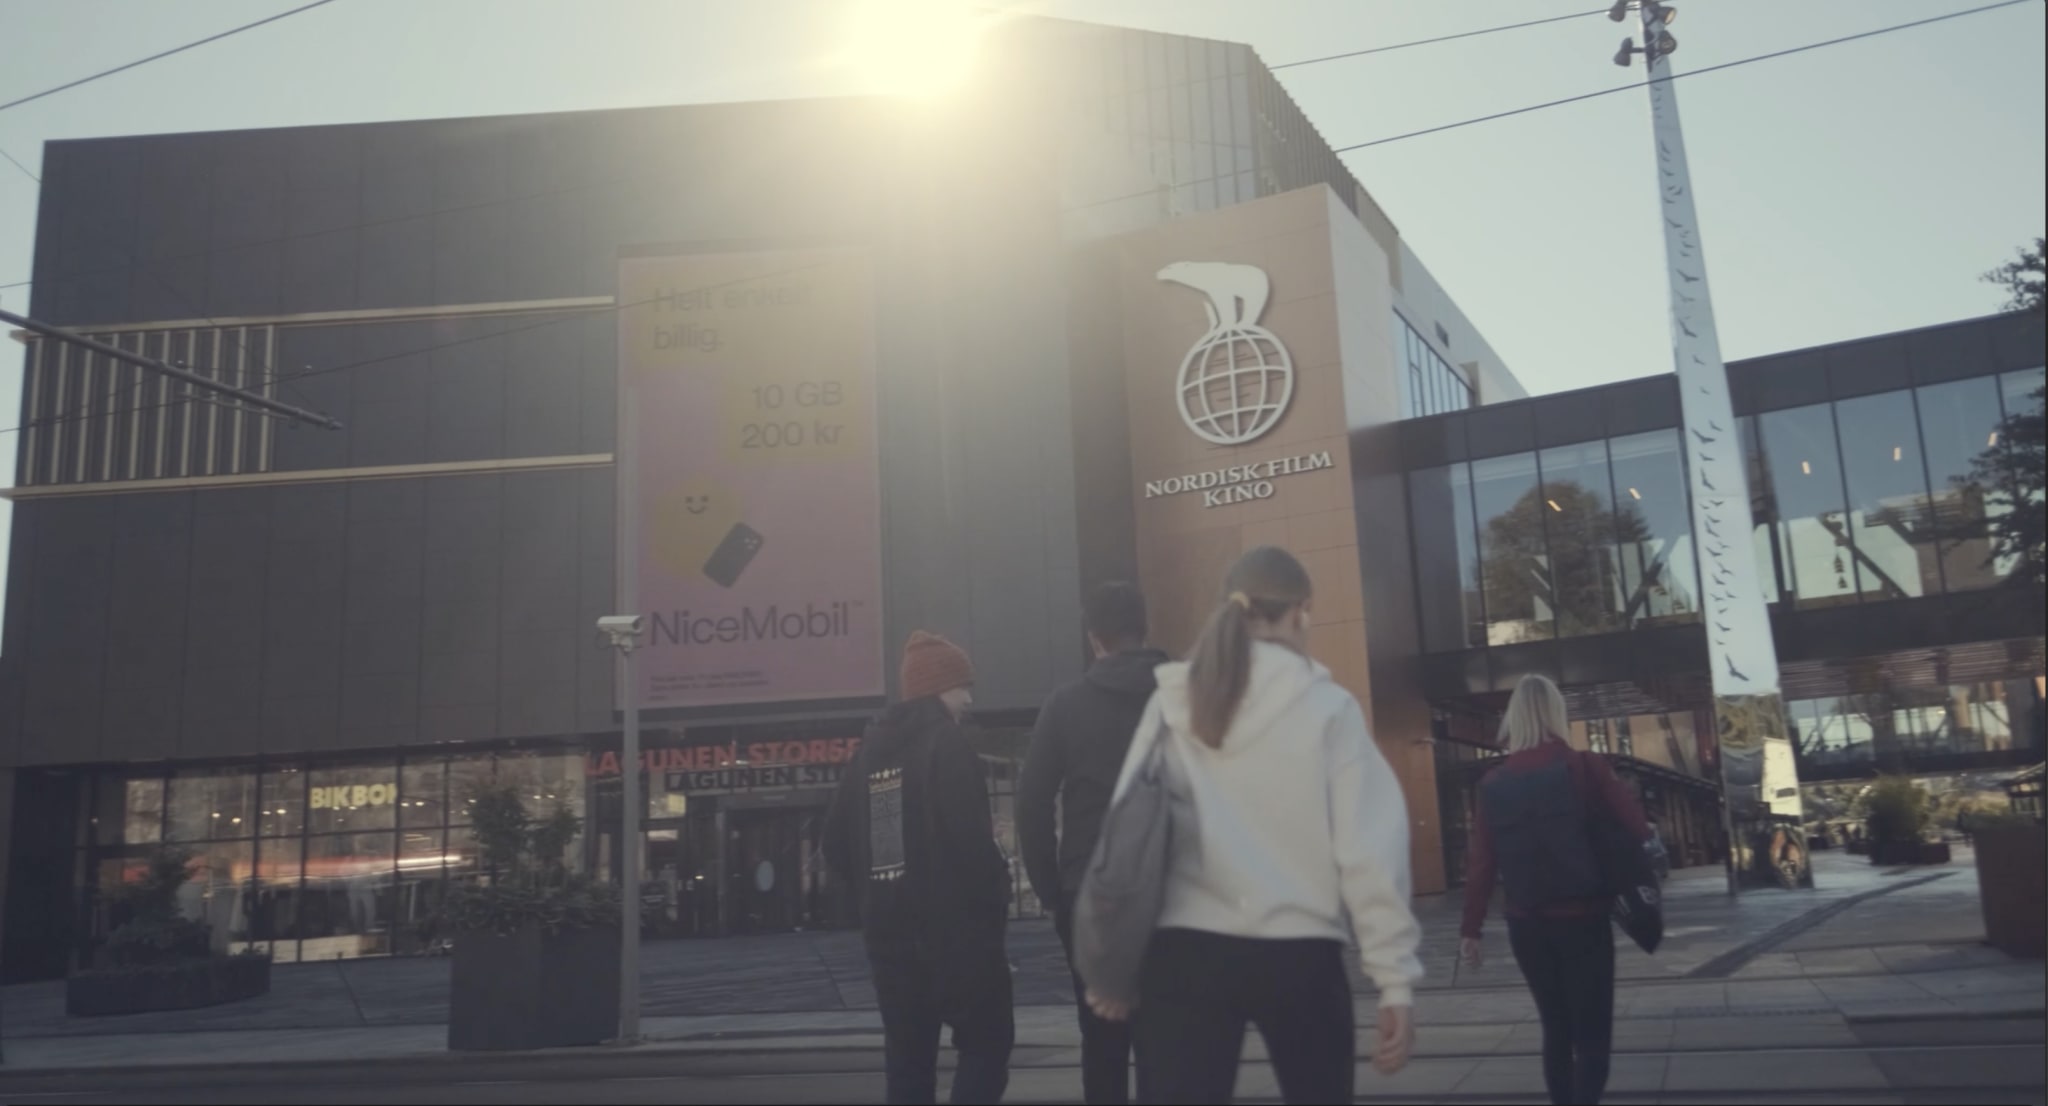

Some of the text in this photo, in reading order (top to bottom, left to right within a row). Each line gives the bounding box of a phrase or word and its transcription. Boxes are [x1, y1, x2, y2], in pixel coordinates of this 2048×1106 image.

[752, 381, 843, 409] 10 GB
[741, 420, 844, 449] 200 kr
[1145, 451, 1334, 497] NORDISK FILM
[1204, 481, 1275, 507] KINO
[650, 602, 849, 646] NiceMobil
